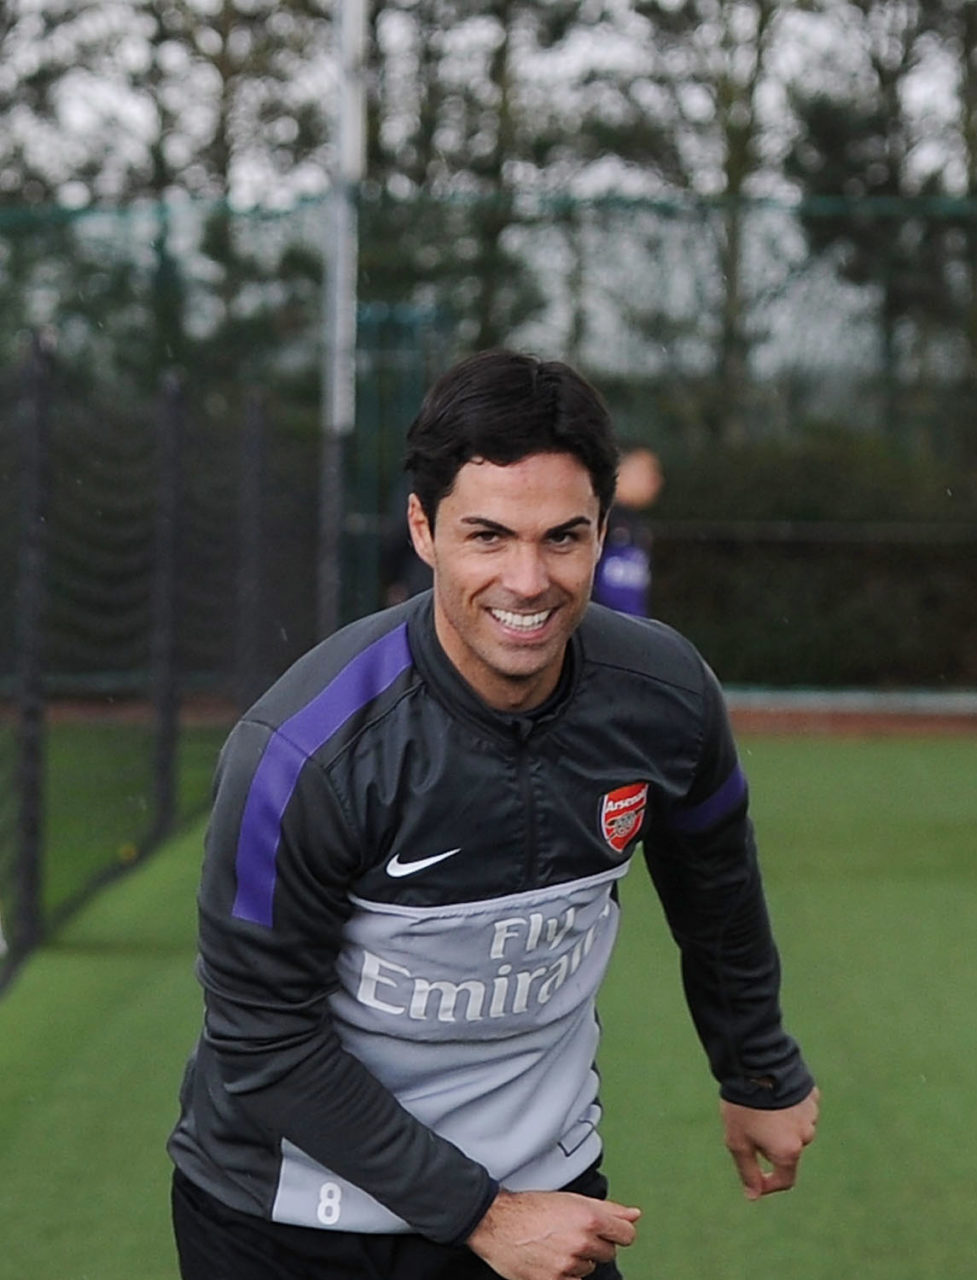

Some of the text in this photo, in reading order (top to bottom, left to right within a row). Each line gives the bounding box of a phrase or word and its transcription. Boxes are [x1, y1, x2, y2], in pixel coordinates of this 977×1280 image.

[490, 907, 575, 959] Fly
[356, 904, 610, 1022] Emira
[317, 1182, 342, 1225] 8
